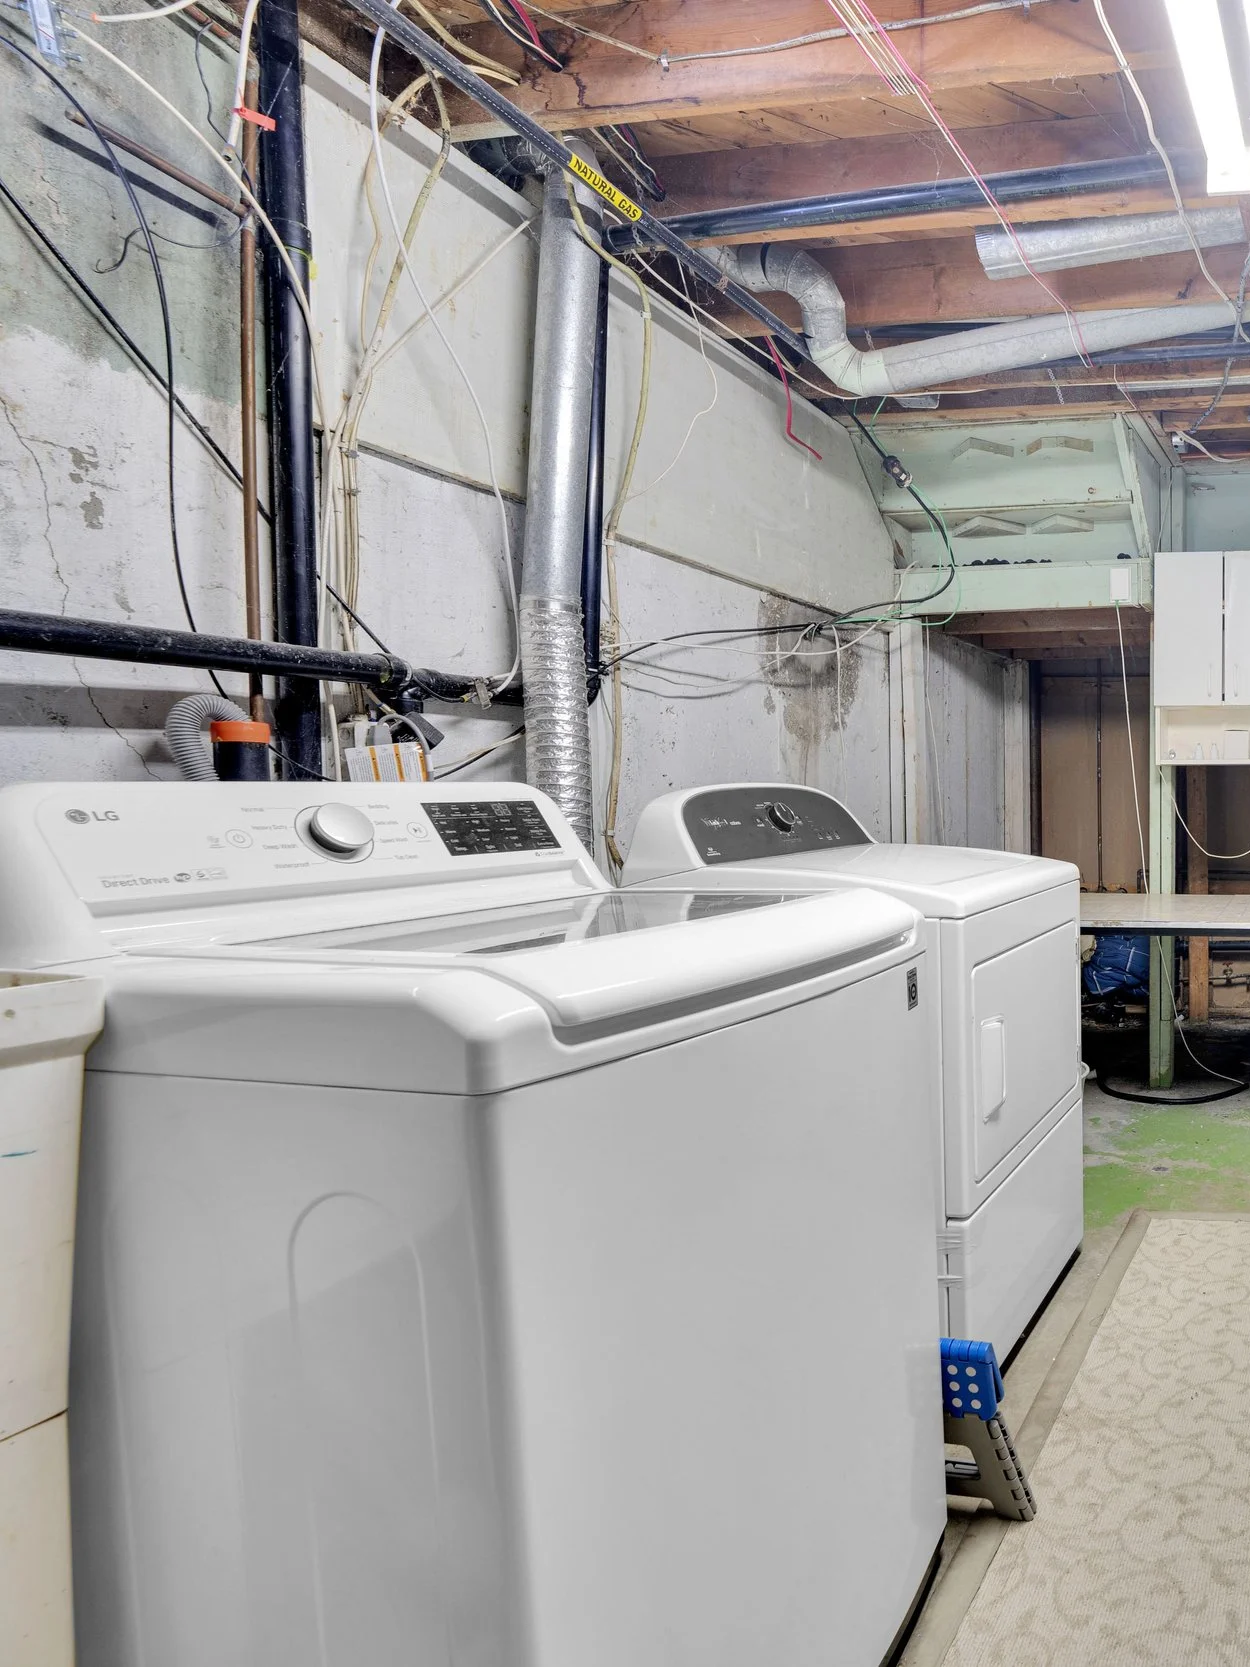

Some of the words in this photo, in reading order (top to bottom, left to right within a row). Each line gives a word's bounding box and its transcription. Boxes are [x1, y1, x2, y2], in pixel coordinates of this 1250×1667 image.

[574, 158, 617, 202] NATURAL
[618, 198, 639, 219] GAS
[92, 810, 120, 822] LG
[100, 878, 139, 888] Direct
[139, 876, 170, 886] Drive
